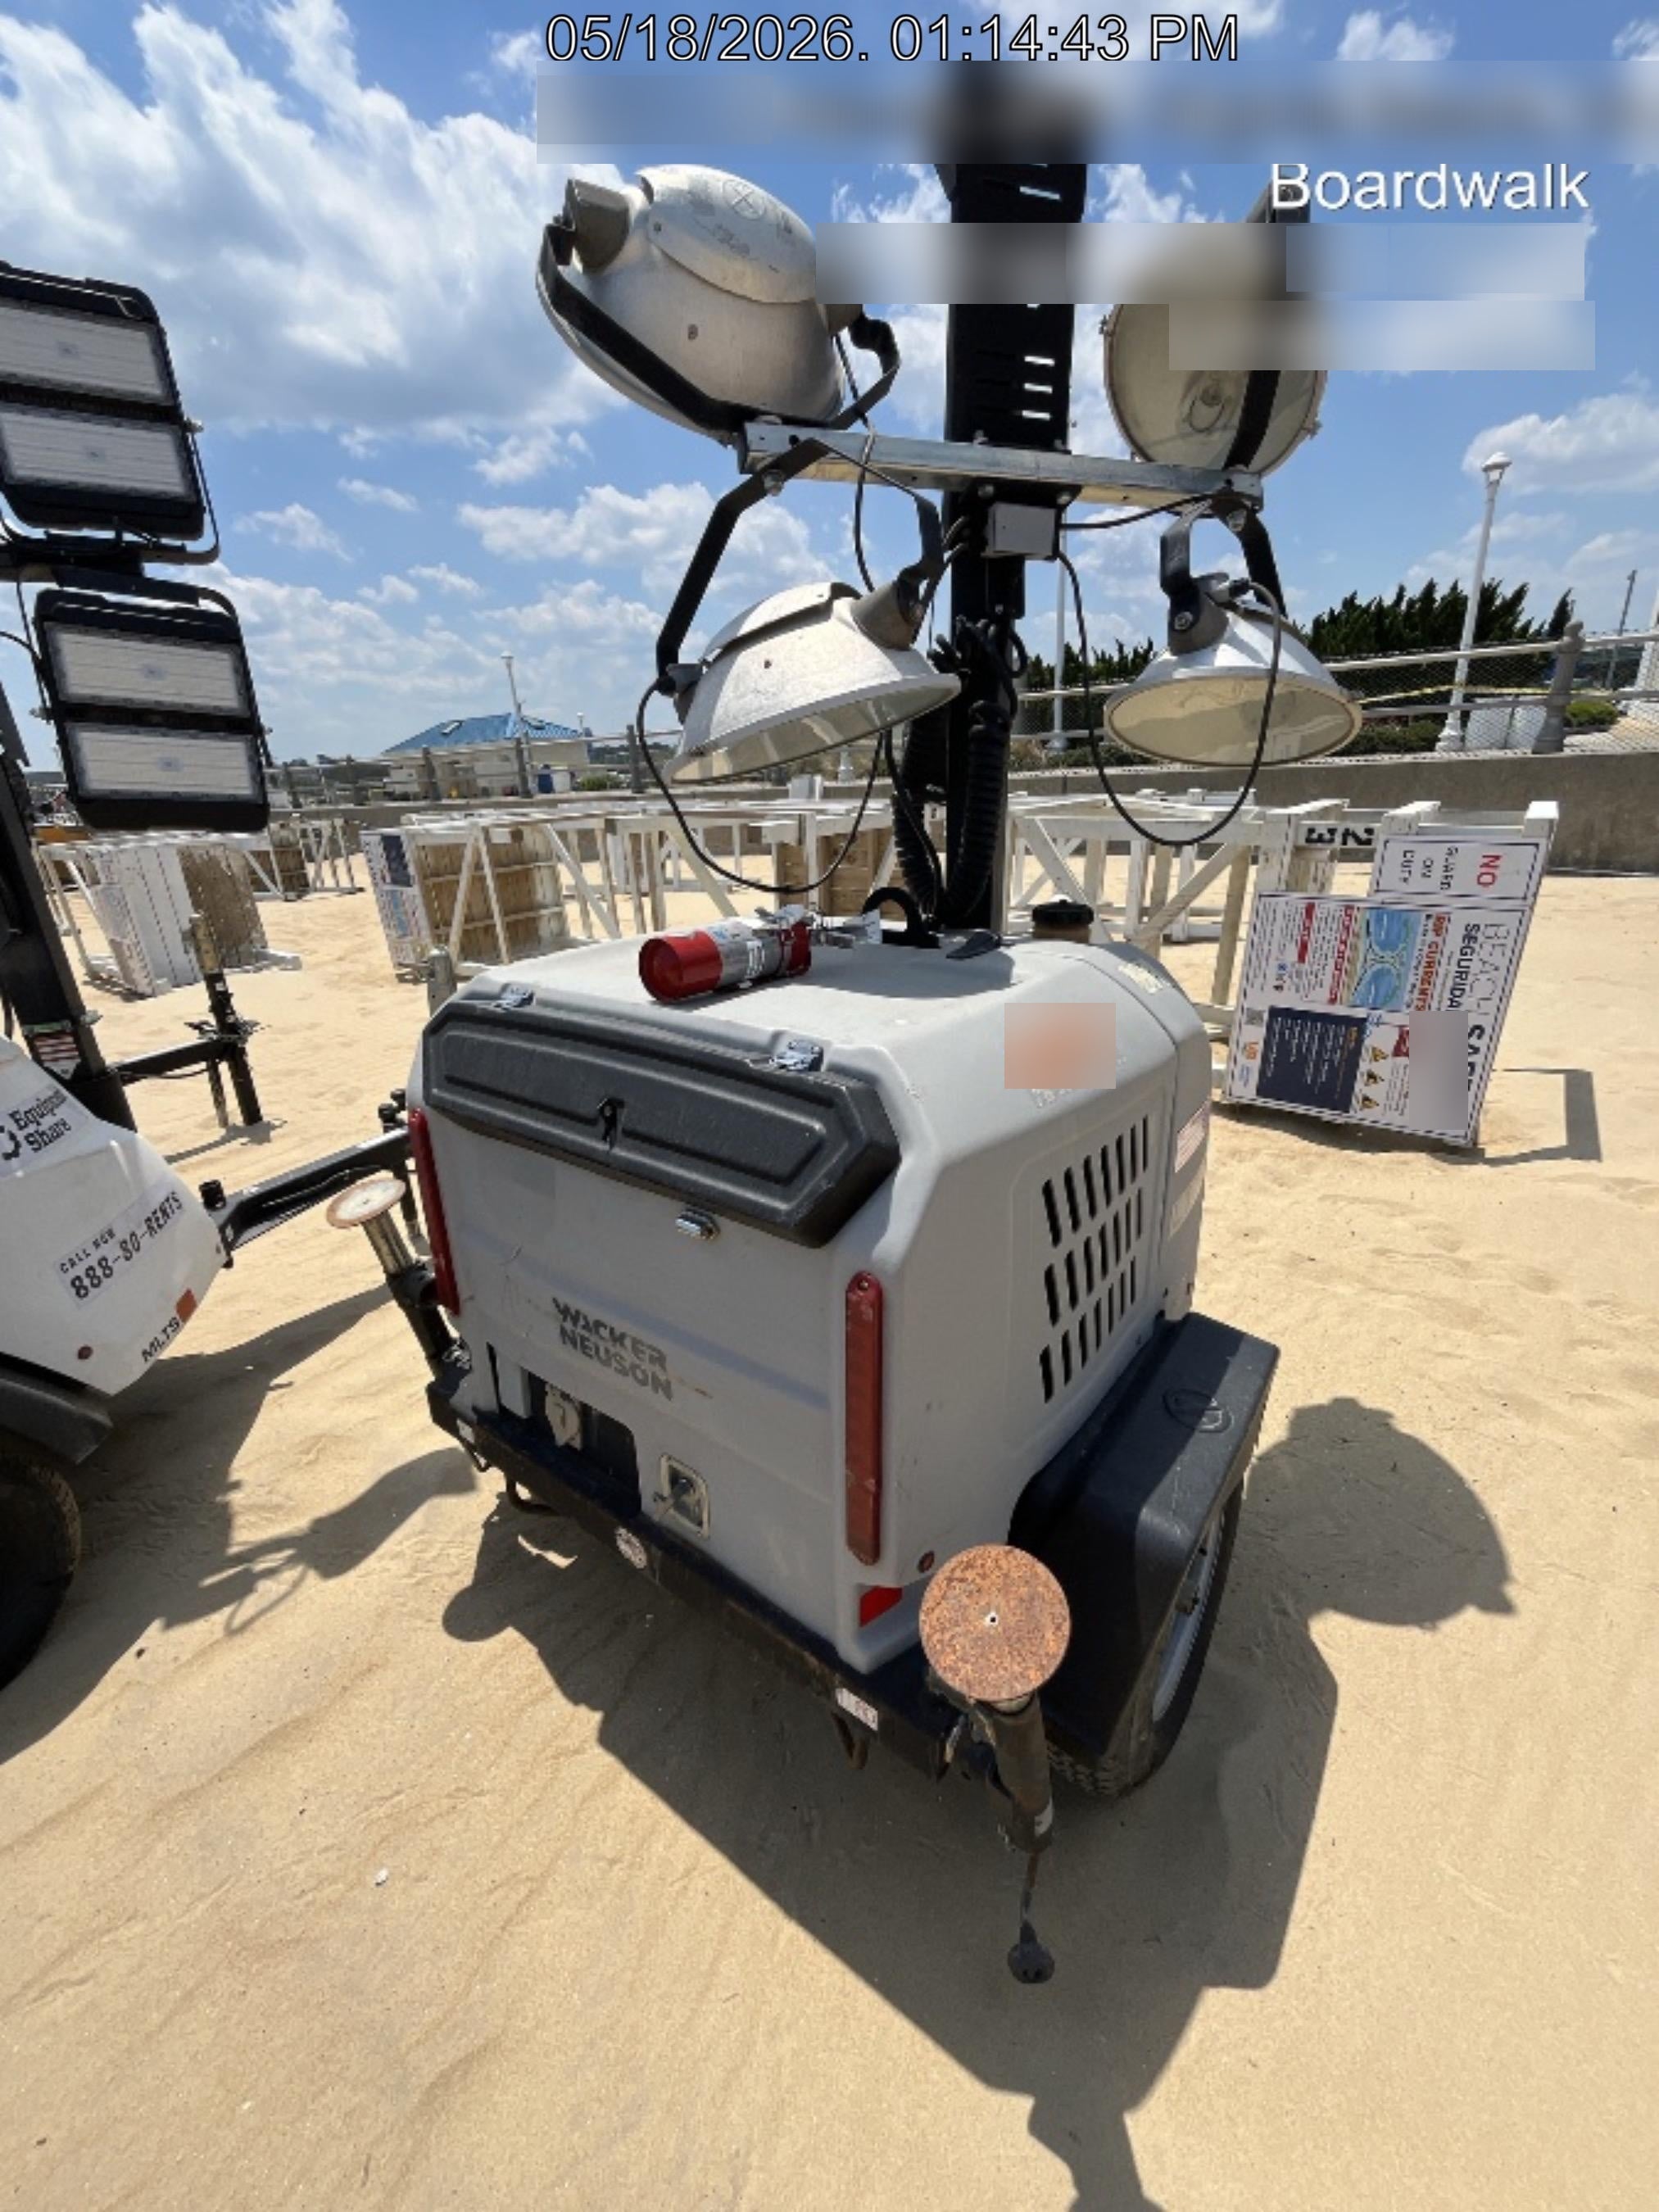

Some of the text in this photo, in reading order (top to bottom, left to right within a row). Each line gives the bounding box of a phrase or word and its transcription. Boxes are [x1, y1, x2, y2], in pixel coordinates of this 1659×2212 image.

[1421, 858, 1434, 878] ON
[1477, 854, 1502, 887] NO
[1432, 915, 1446, 936] RIP
[1444, 923, 1480, 1011] SEGURIDA
[24, 1118, 71, 1153] Share
[61, 1249, 91, 1273] CALL
[70, 1191, 183, 1299] 888-80-RENTS
[552, 1297, 667, 1373] WACKER
[560, 1323, 673, 1402] NEUSON
